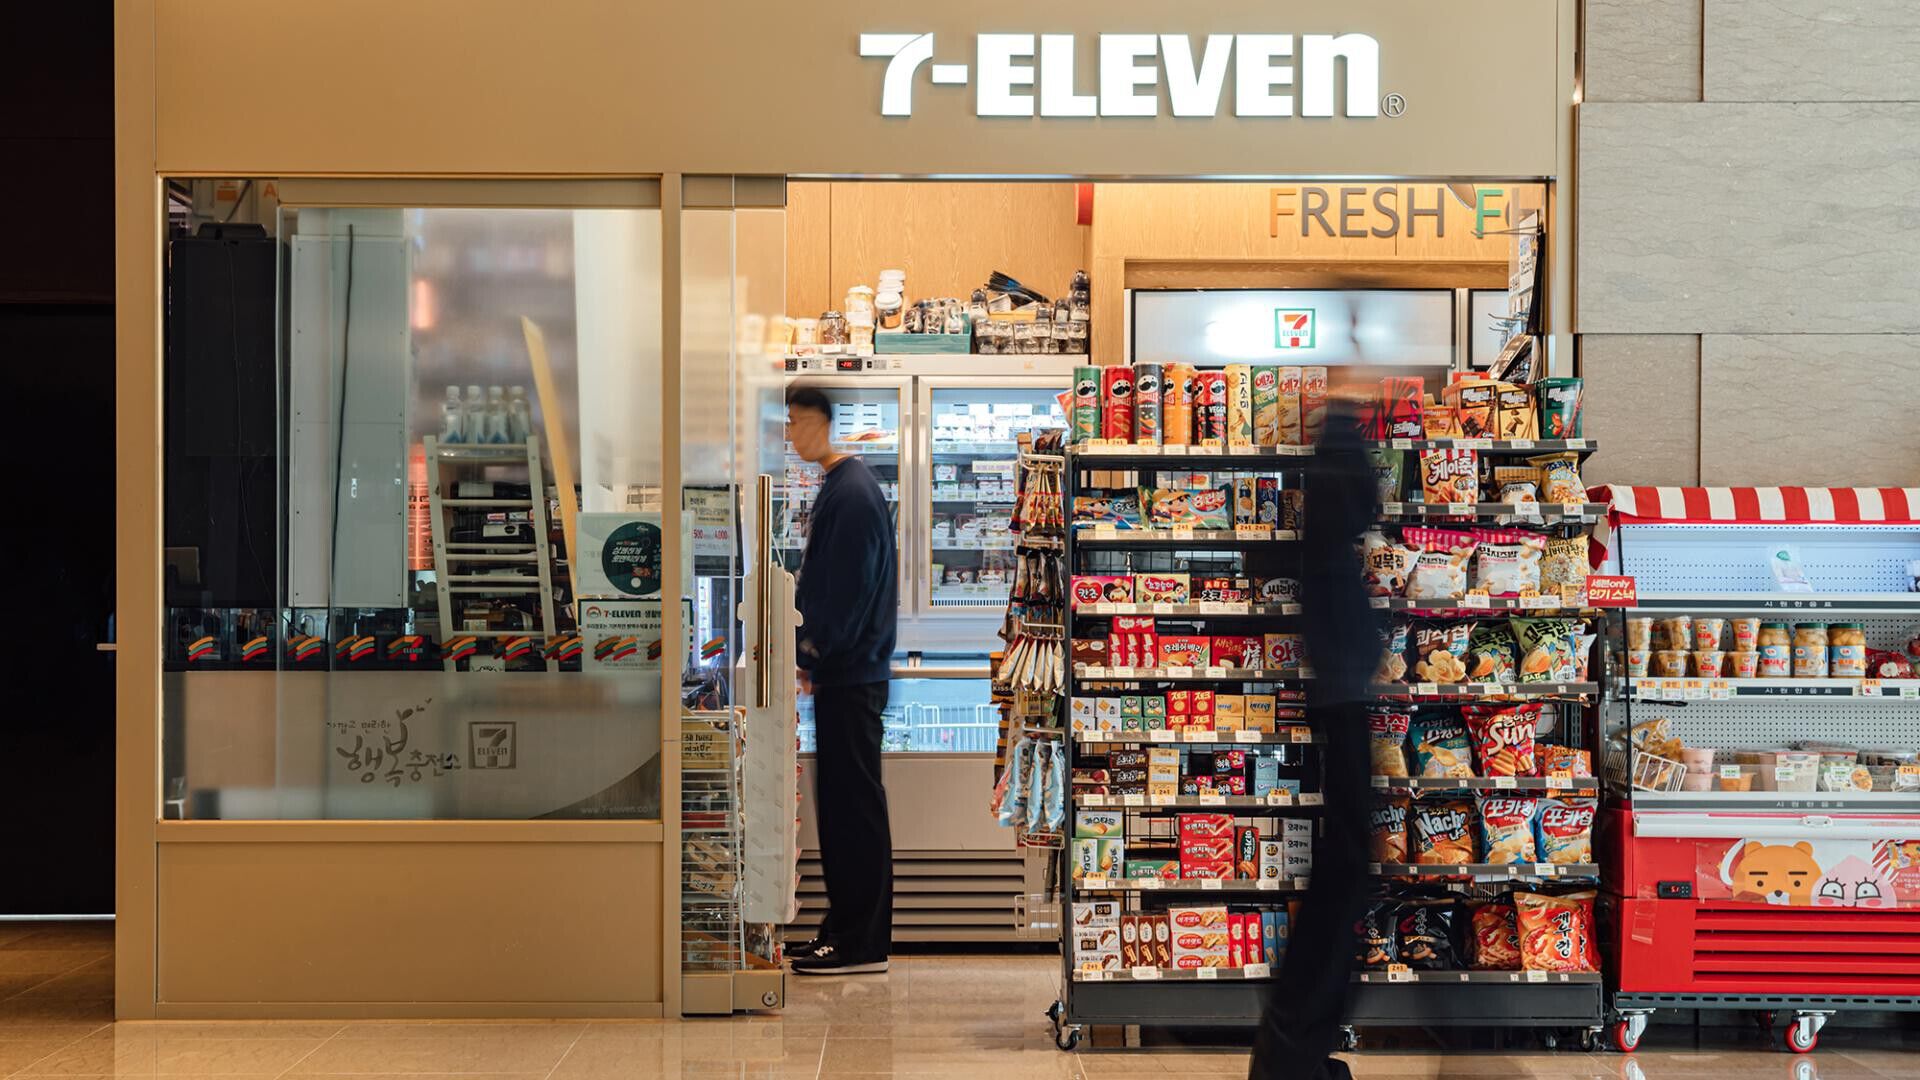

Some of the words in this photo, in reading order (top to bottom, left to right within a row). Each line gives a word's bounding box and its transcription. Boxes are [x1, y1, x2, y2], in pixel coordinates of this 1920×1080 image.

[1270, 187, 1445, 238] FRESH
[1239, 372, 1249, 409] 고소미
[1427, 457, 1473, 486] 케이준
[1373, 552, 1404, 570] 꼬북칩
[1204, 580, 1230, 589] ABC
[1588, 588, 1611, 601] 인기
[1611, 589, 1634, 601] 스낵
[1523, 621, 1567, 643] 꼬북칩
[1243, 645, 1264, 670] 情
[1487, 722, 1534, 756] Sun
[1486, 799, 1535, 818] 포카칩
[1543, 808, 1594, 827] 포카칩
[1085, 816, 1117, 826] 카스타드
[1414, 809, 1467, 840] Nacho
[1552, 911, 1574, 958] 새우깡
